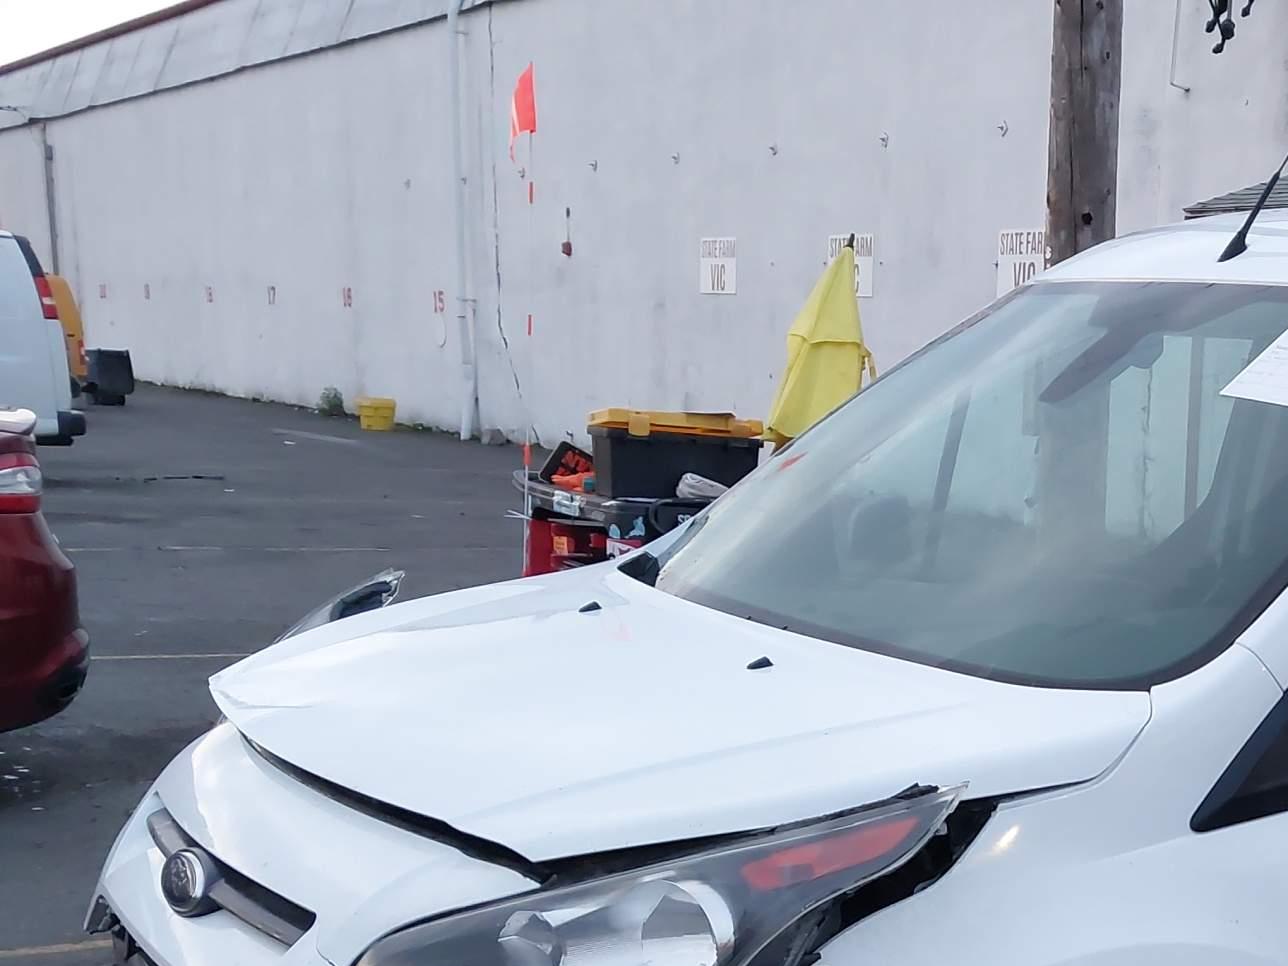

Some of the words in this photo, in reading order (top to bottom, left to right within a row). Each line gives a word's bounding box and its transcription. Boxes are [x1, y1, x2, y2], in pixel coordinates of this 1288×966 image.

[830, 237, 850, 258] STAT
[855, 236, 873, 257] ARM
[1000, 231, 1024, 255] STATE
[1026, 231, 1045, 255] FAR
[710, 263, 726, 291] VIC
[1013, 261, 1036, 288] VIC
[267, 285, 276, 305] 17
[433, 290, 446, 313] 15
